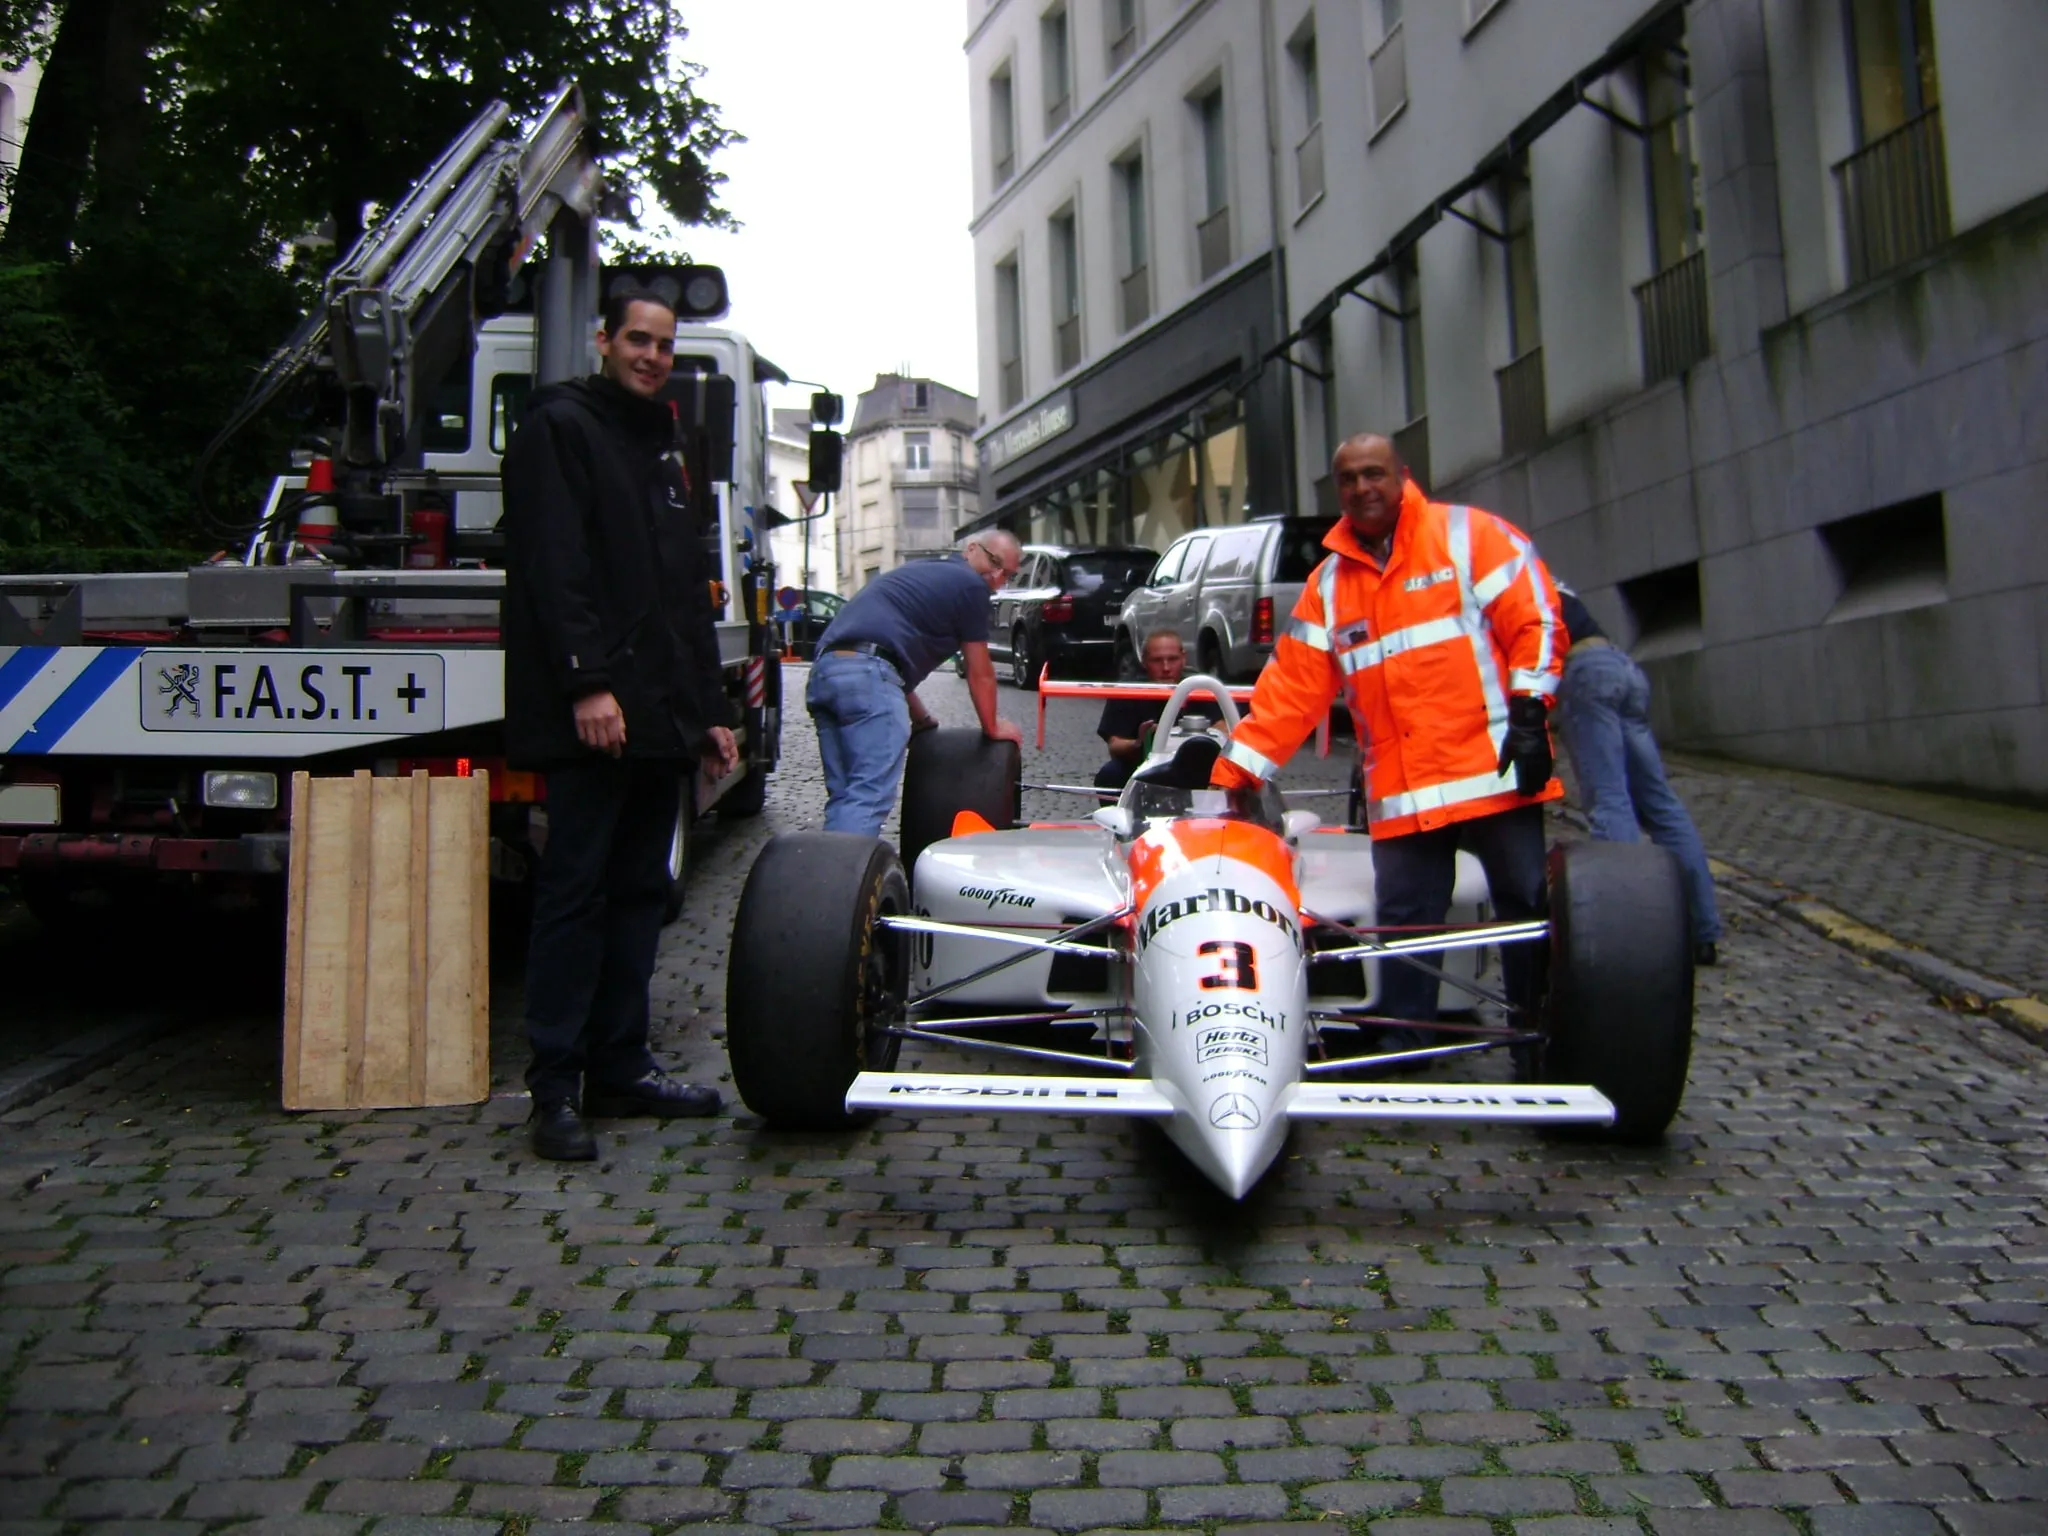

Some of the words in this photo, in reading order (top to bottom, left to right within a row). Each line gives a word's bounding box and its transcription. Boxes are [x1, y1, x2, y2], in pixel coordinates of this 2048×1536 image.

[214, 664, 378, 721] F.A.S.T.
[1197, 940, 1260, 992] 3
[1186, 1002, 1276, 1030] BOSCH
[1203, 1030, 1260, 1045] Hertz
[889, 1083, 1050, 1098] Mobil
[1337, 1093, 1501, 1105] Mobil
